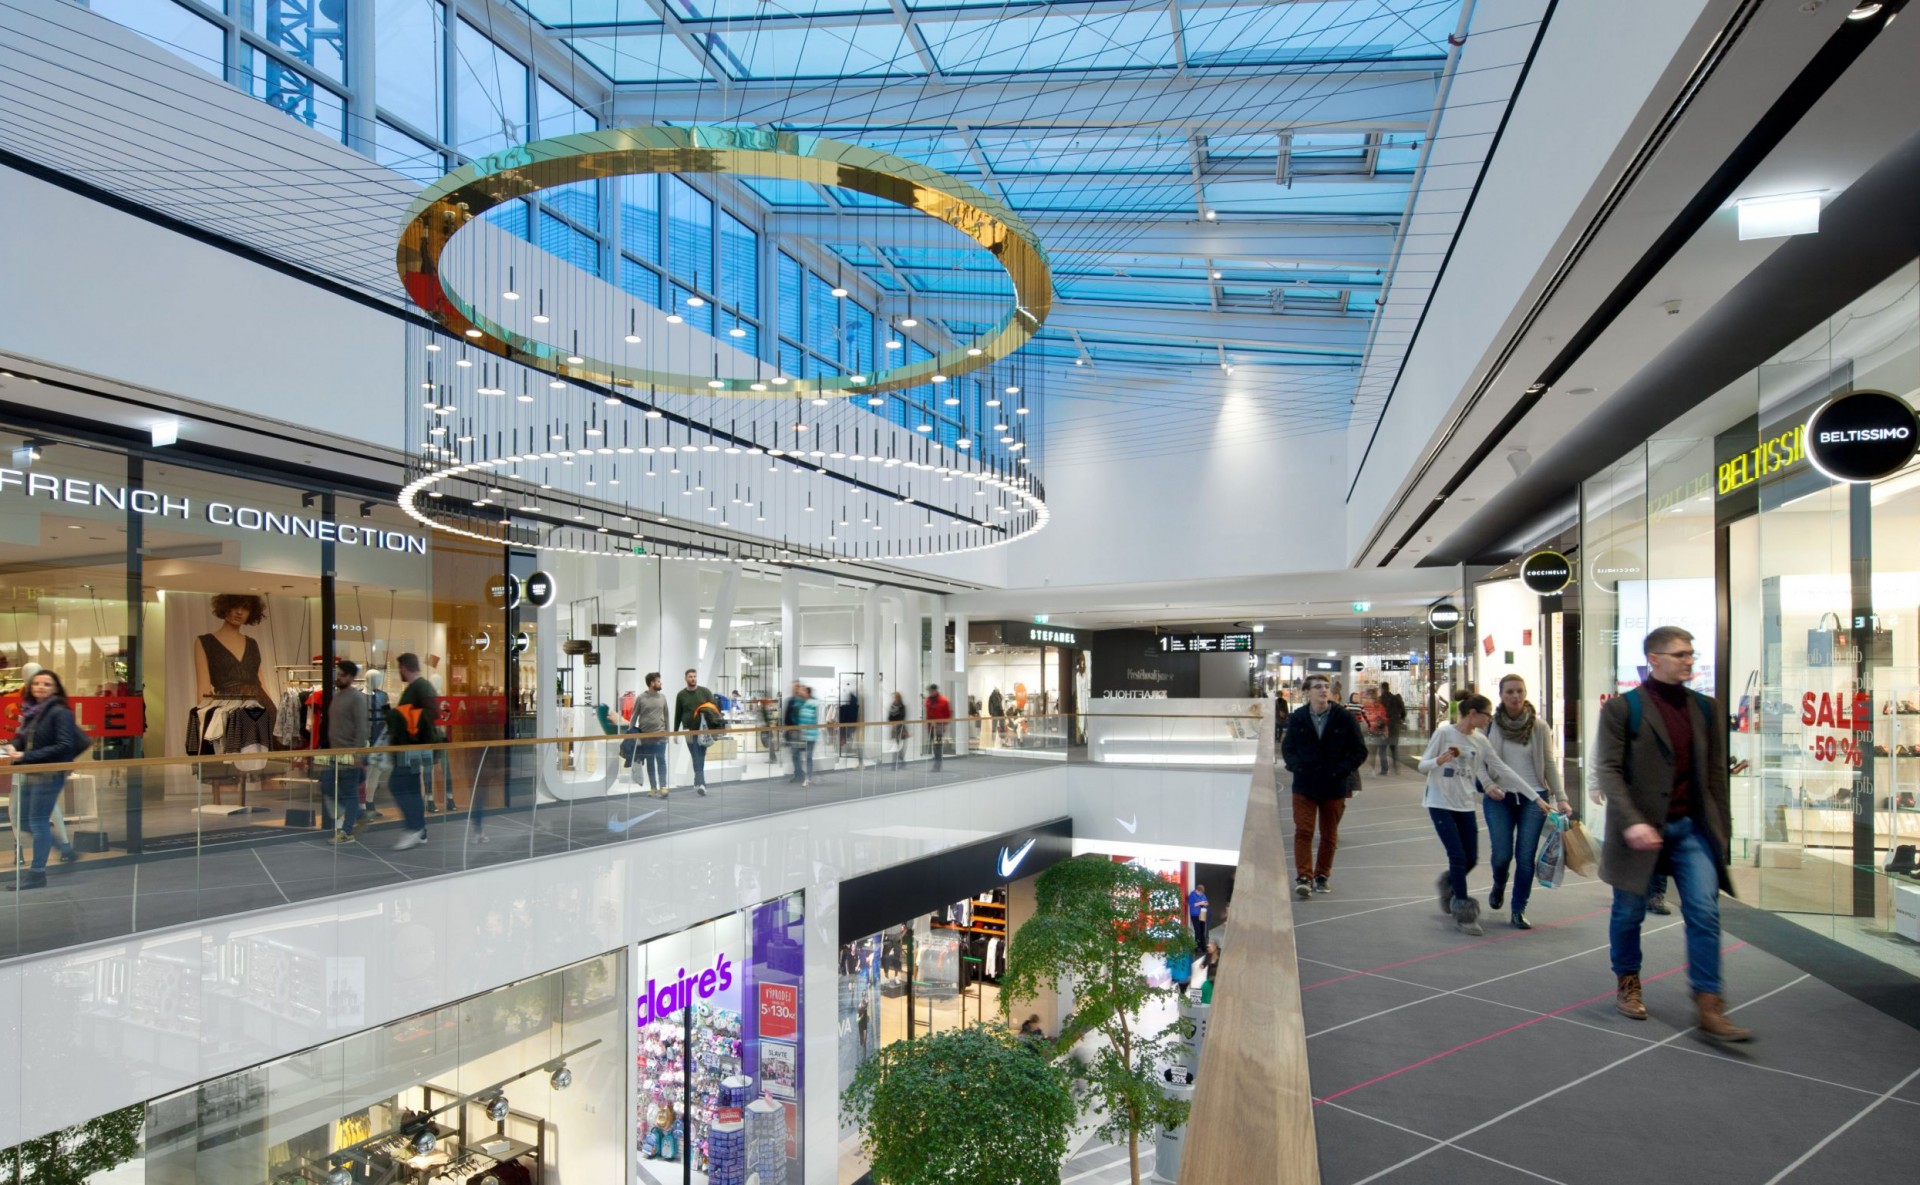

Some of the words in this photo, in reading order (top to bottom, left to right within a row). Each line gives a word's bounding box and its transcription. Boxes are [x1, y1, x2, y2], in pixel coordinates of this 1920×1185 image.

[1820, 427, 1909, 443] BELTISSIMO
[1718, 424, 1806, 495] BELTISSI
[0, 468, 190, 519] FRENCH
[207, 502, 427, 555] CONNECTION
[1526, 569, 1567, 577] COCCINELLE
[1030, 629, 1076, 643] STEFANEL
[1160, 637, 1167, 651] 1
[440, 700, 499, 722] SALE
[1801, 691, 1871, 730] SALE
[1808, 735, 1837, 763] -50
[1841, 737, 1862, 766] %
[637, 953, 732, 1029] claire's
